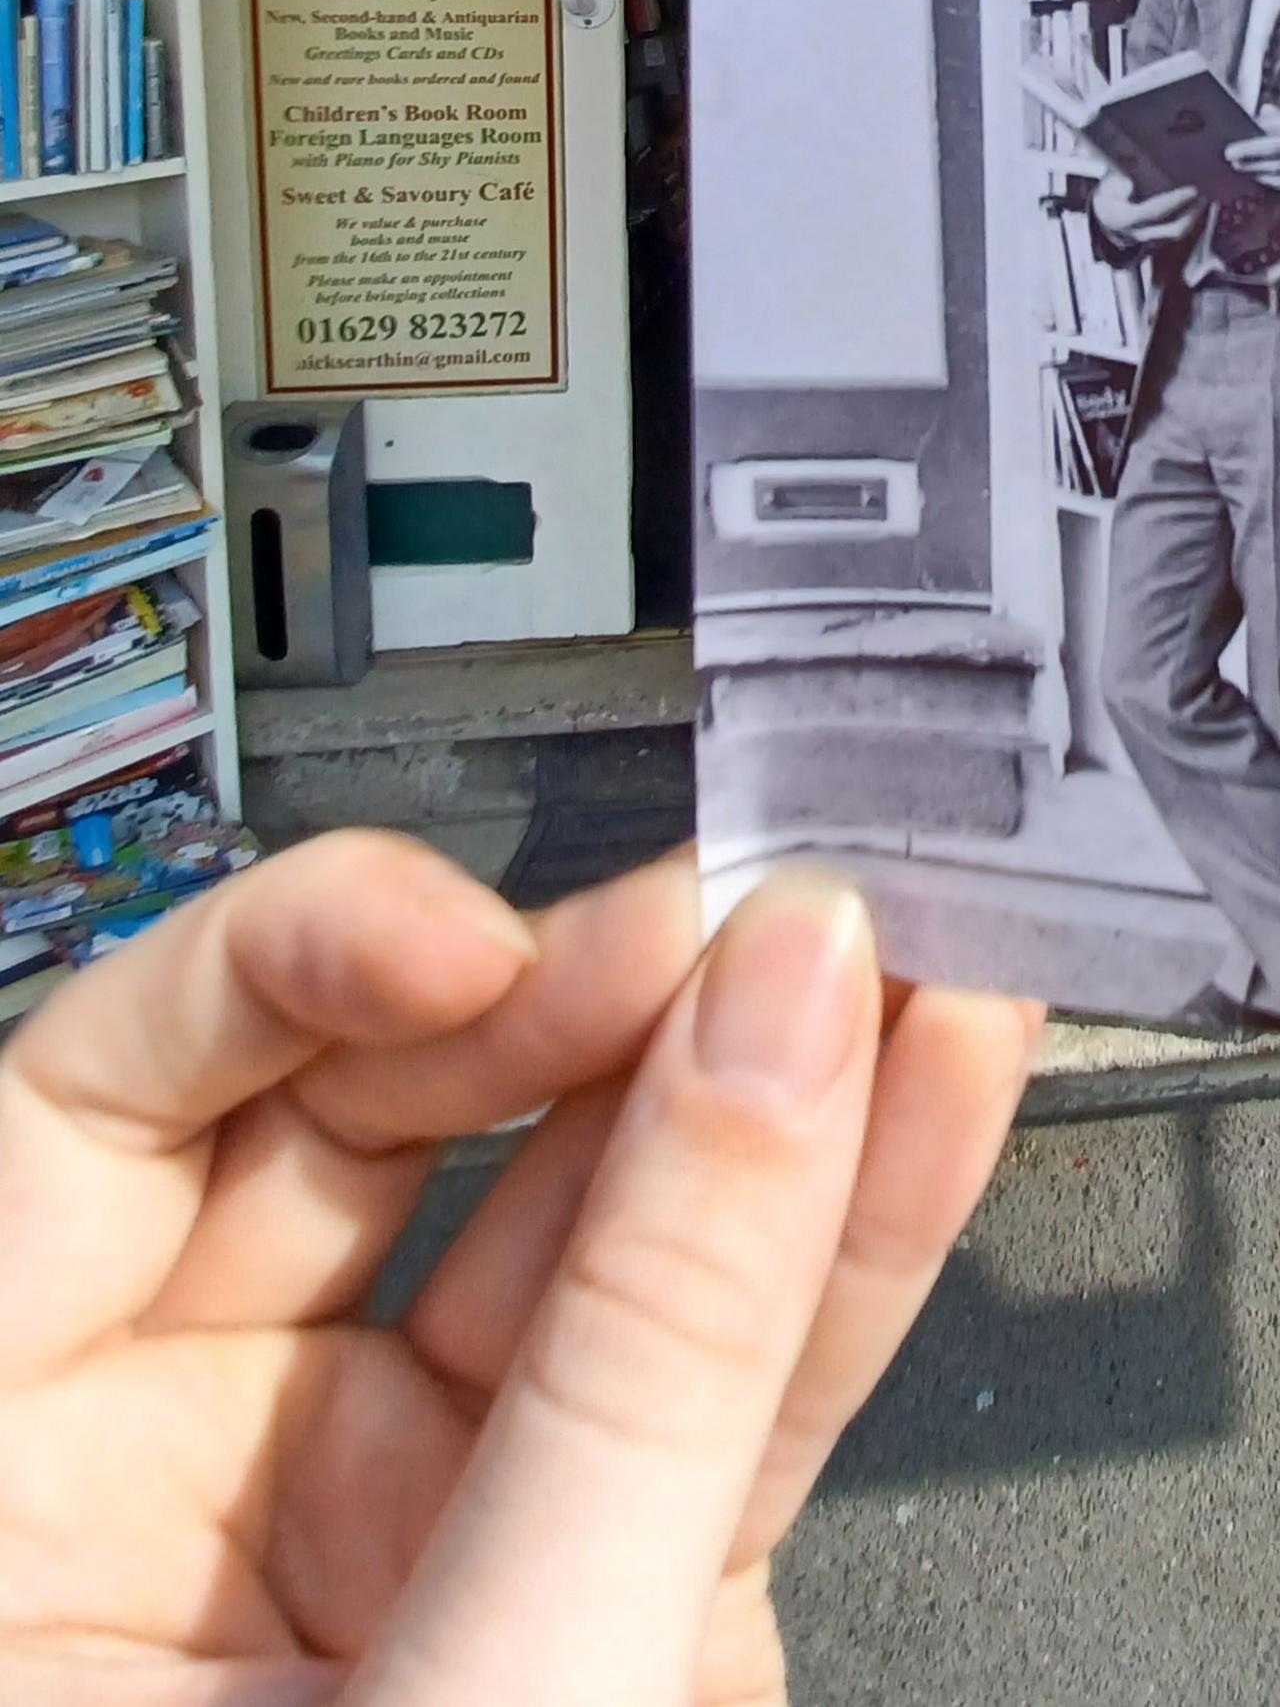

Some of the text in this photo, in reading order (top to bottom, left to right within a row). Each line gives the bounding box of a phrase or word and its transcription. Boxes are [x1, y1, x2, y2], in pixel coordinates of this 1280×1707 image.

[310, 10, 417, 24] Second-hand
[422, 11, 436, 24] &
[442, 11, 540, 27] Antiquarian
[335, 27, 474, 42] Books and Music
[305, 46, 504, 63] Greetings Cards and CDs
[302, 74, 332, 86] and
[335, 76, 365, 86] rare
[368, 73, 409, 85] books
[412, 73, 466, 85] ordered
[469, 73, 496, 85] and
[497, 72, 541, 88] found
[404, 105, 459, 122] Book
[466, 104, 528, 122] Room
[268, 128, 542, 151] Foreign Languages Room
[291, 151, 521, 170] with Piano for Shy Pianists
[281, 181, 535, 206] Sweet & Savoury Café
[335, 216, 488, 232] We value & purchase
[350, 233, 471, 246] books and music
[291, 254, 330, 269] from
[333, 252, 357, 265] the
[395, 252, 411, 263] to
[414, 250, 437, 262] the
[441, 249, 470, 262] 21st
[473, 249, 527, 262] century
[306, 270, 513, 288] Please make an appointment
[315, 287, 506, 306] before bringing collections
[297, 310, 527, 344] 01629 823272
